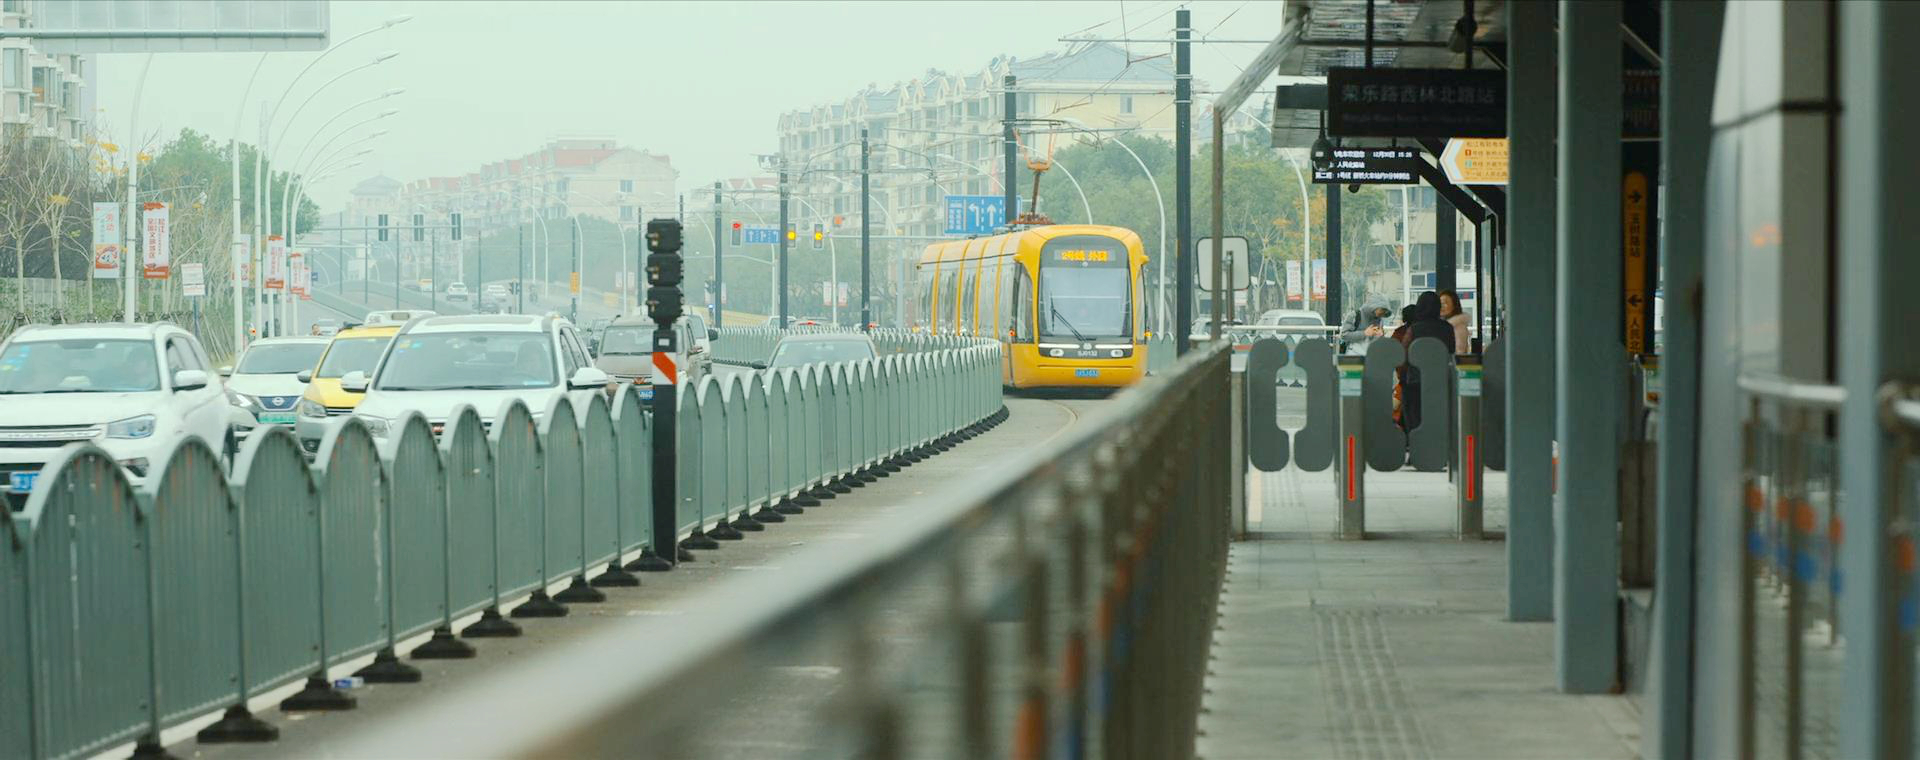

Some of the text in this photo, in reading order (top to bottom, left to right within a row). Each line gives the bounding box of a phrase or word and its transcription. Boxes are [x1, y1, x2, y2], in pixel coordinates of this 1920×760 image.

[1342, 84, 1496, 103] 荣乐路西林北路站
